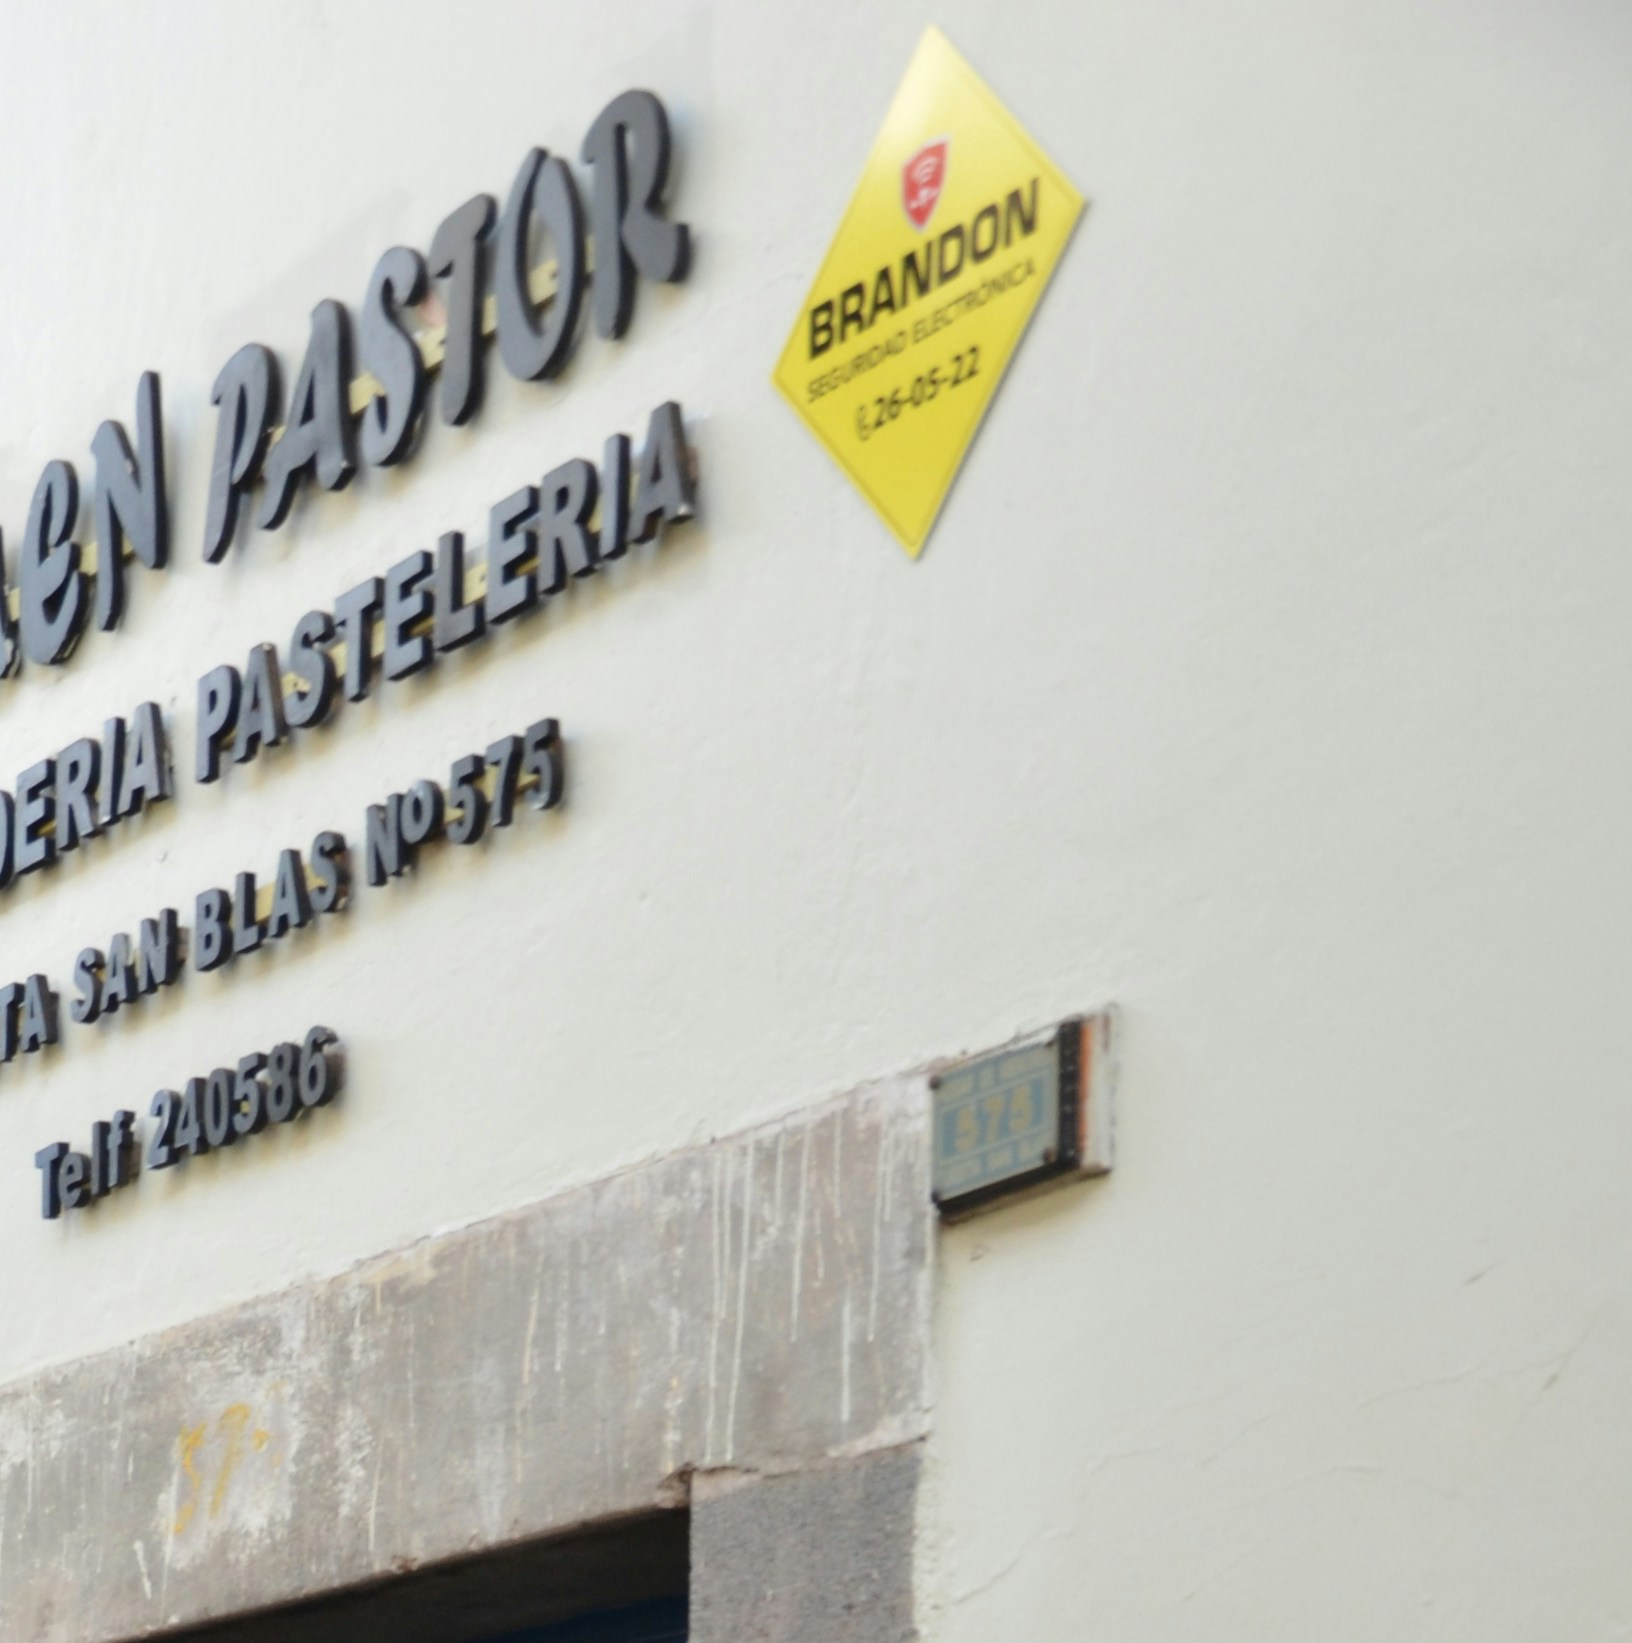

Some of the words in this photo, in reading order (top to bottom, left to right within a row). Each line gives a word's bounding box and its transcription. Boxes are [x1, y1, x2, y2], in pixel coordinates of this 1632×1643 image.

[202, 87, 693, 565] PASTOR
[806, 328, 908, 403] SEGURIDAD
[807, 176, 1041, 362] BRANDON
[196, 400, 696, 784] PASTELERIA
[71, 907, 180, 1024] SAN
[195, 830, 351, 972] BLAS
[35, 1109, 136, 1220] Telf
[146, 1025, 345, 1170] 240586
